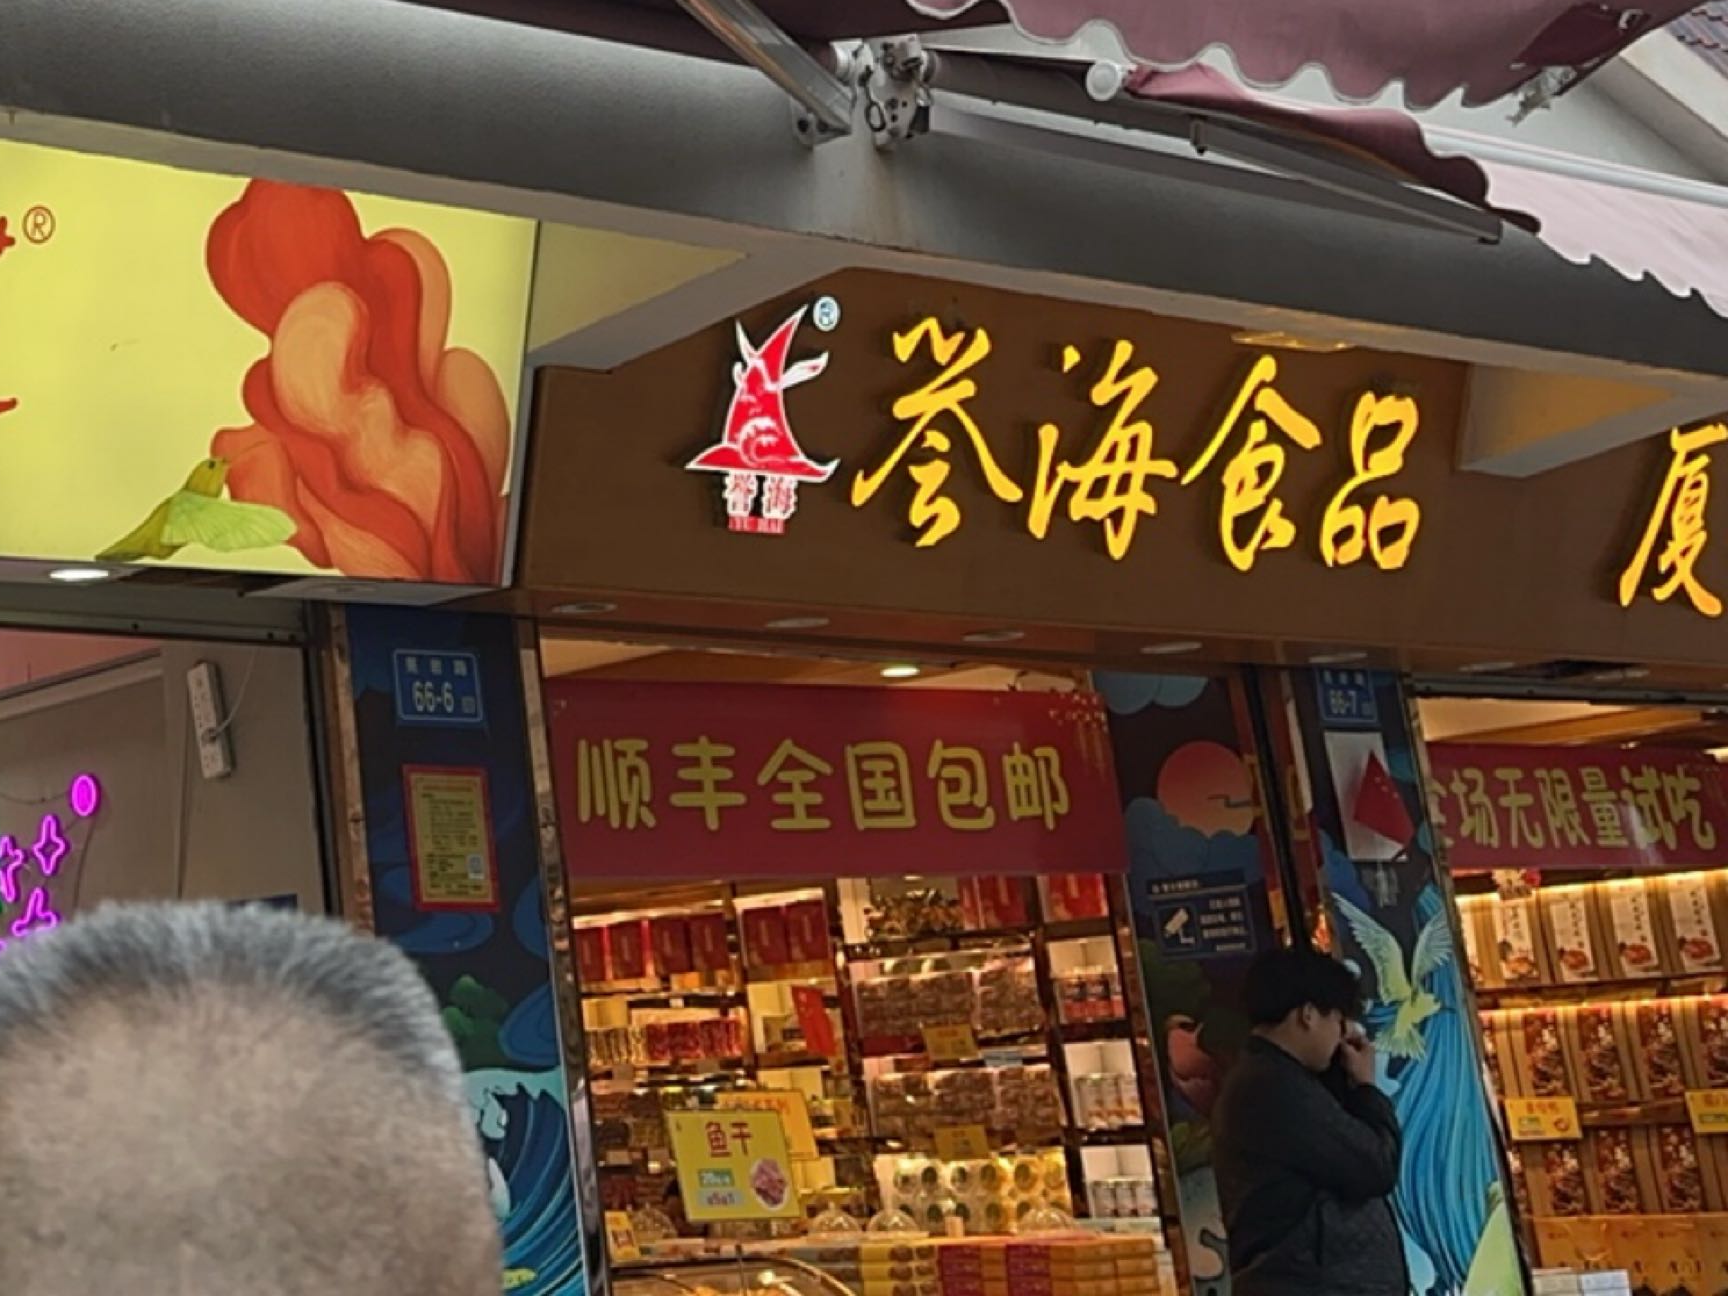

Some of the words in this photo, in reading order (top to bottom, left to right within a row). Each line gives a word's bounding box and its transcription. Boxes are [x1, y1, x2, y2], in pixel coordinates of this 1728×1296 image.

[850, 315, 1424, 572] 誉海食品
[1618, 421, 1728, 619] 厦
[412, 681, 454, 713] 66-6
[576, 734, 1072, 832] 顺丰全国包邮
[705, 1120, 753, 1158] 鱼干
